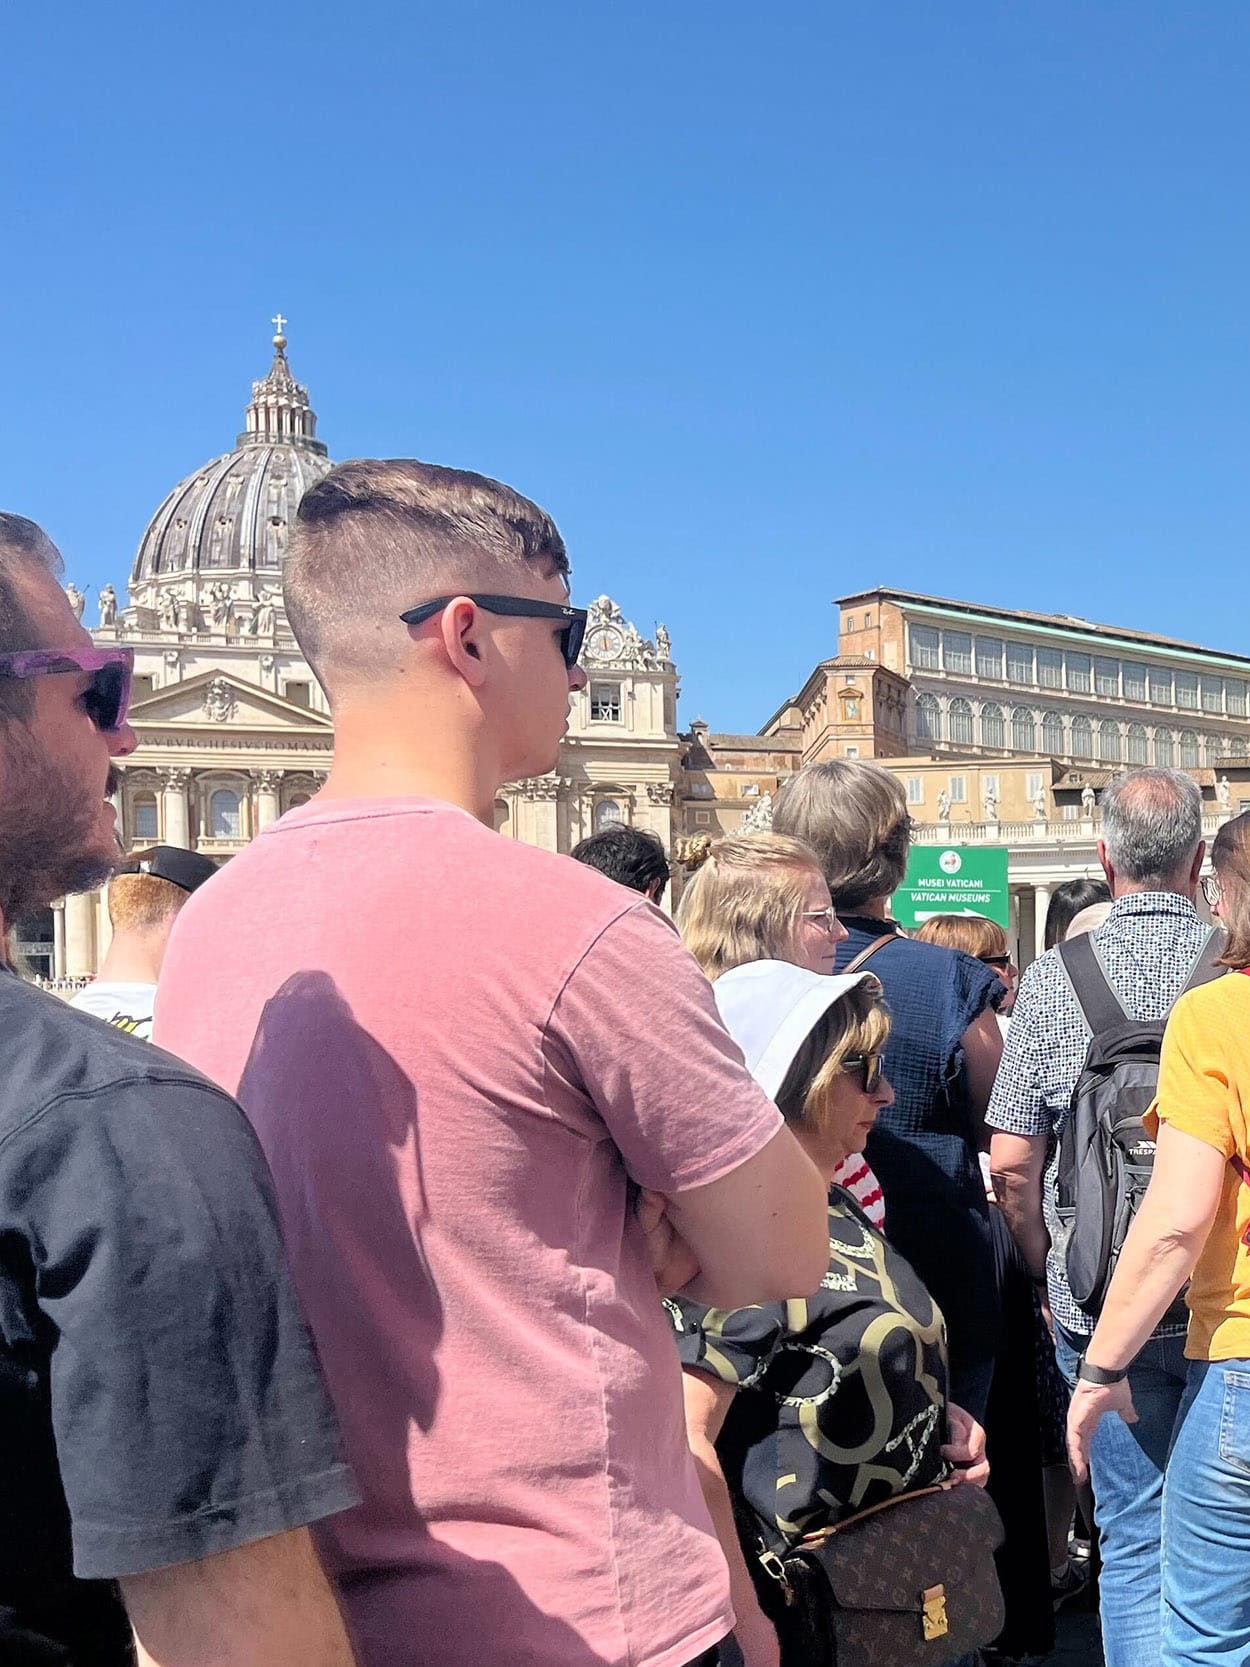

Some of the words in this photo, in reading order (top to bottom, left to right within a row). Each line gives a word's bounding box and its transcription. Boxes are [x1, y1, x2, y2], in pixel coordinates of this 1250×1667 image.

[918, 878, 945, 888] MUSEI
[946, 879, 983, 889] VATICANI
[911, 892, 947, 902] VATICAN
[948, 893, 991, 903] MUSEUMS
